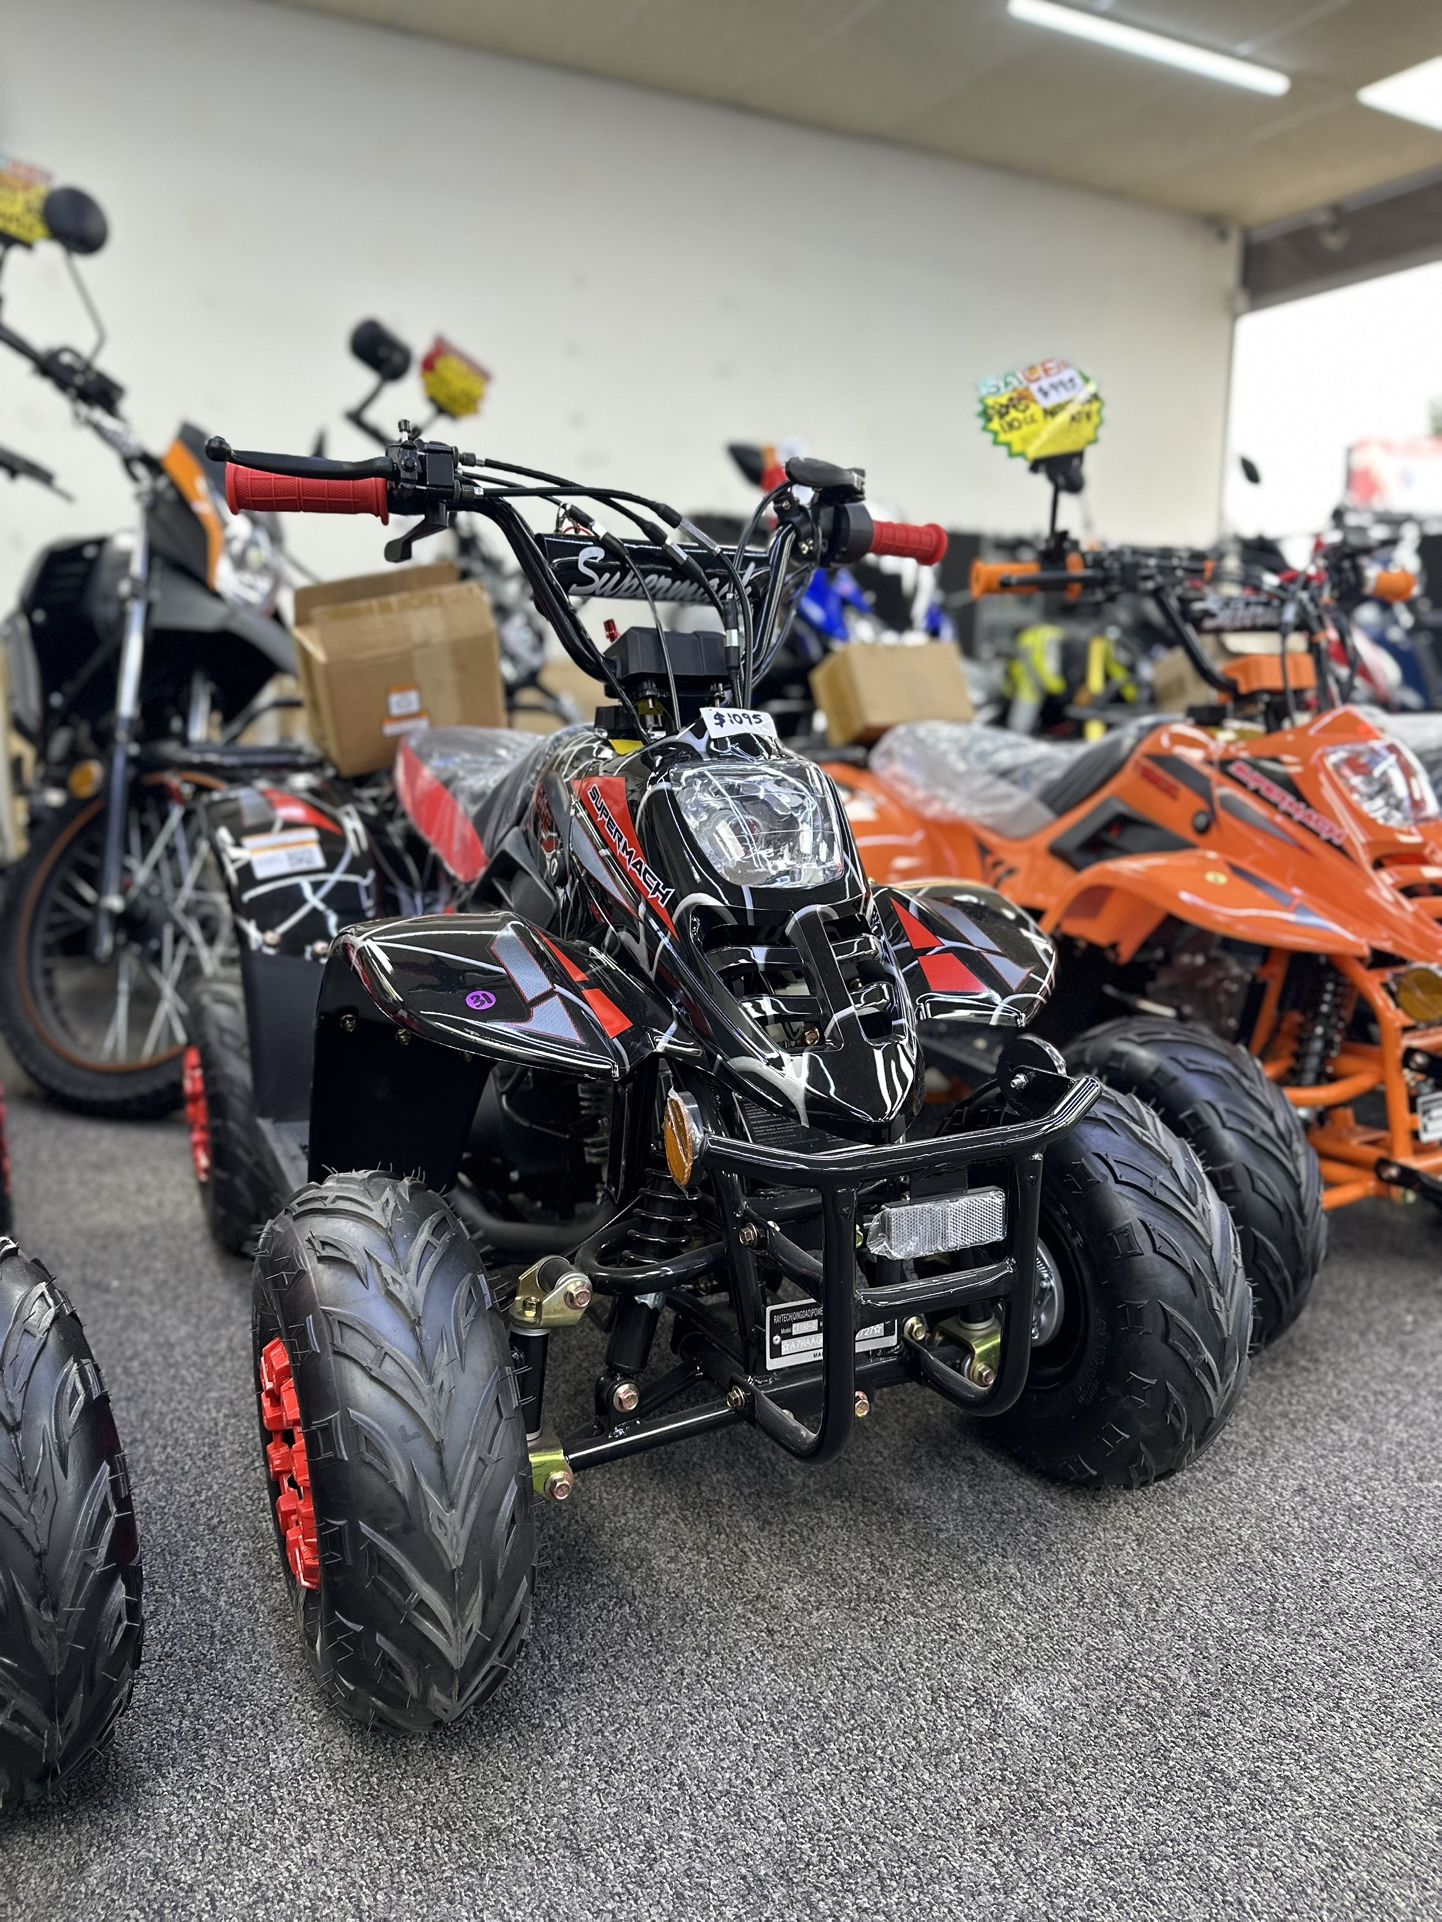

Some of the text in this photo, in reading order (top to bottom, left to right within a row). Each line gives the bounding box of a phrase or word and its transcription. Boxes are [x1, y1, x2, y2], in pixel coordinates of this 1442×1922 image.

[713, 711, 763, 728] $1095
[587, 783, 676, 908] SUPERMACH
[470, 992, 493, 1008] 31
[813, 1350, 823, 1358] MA
